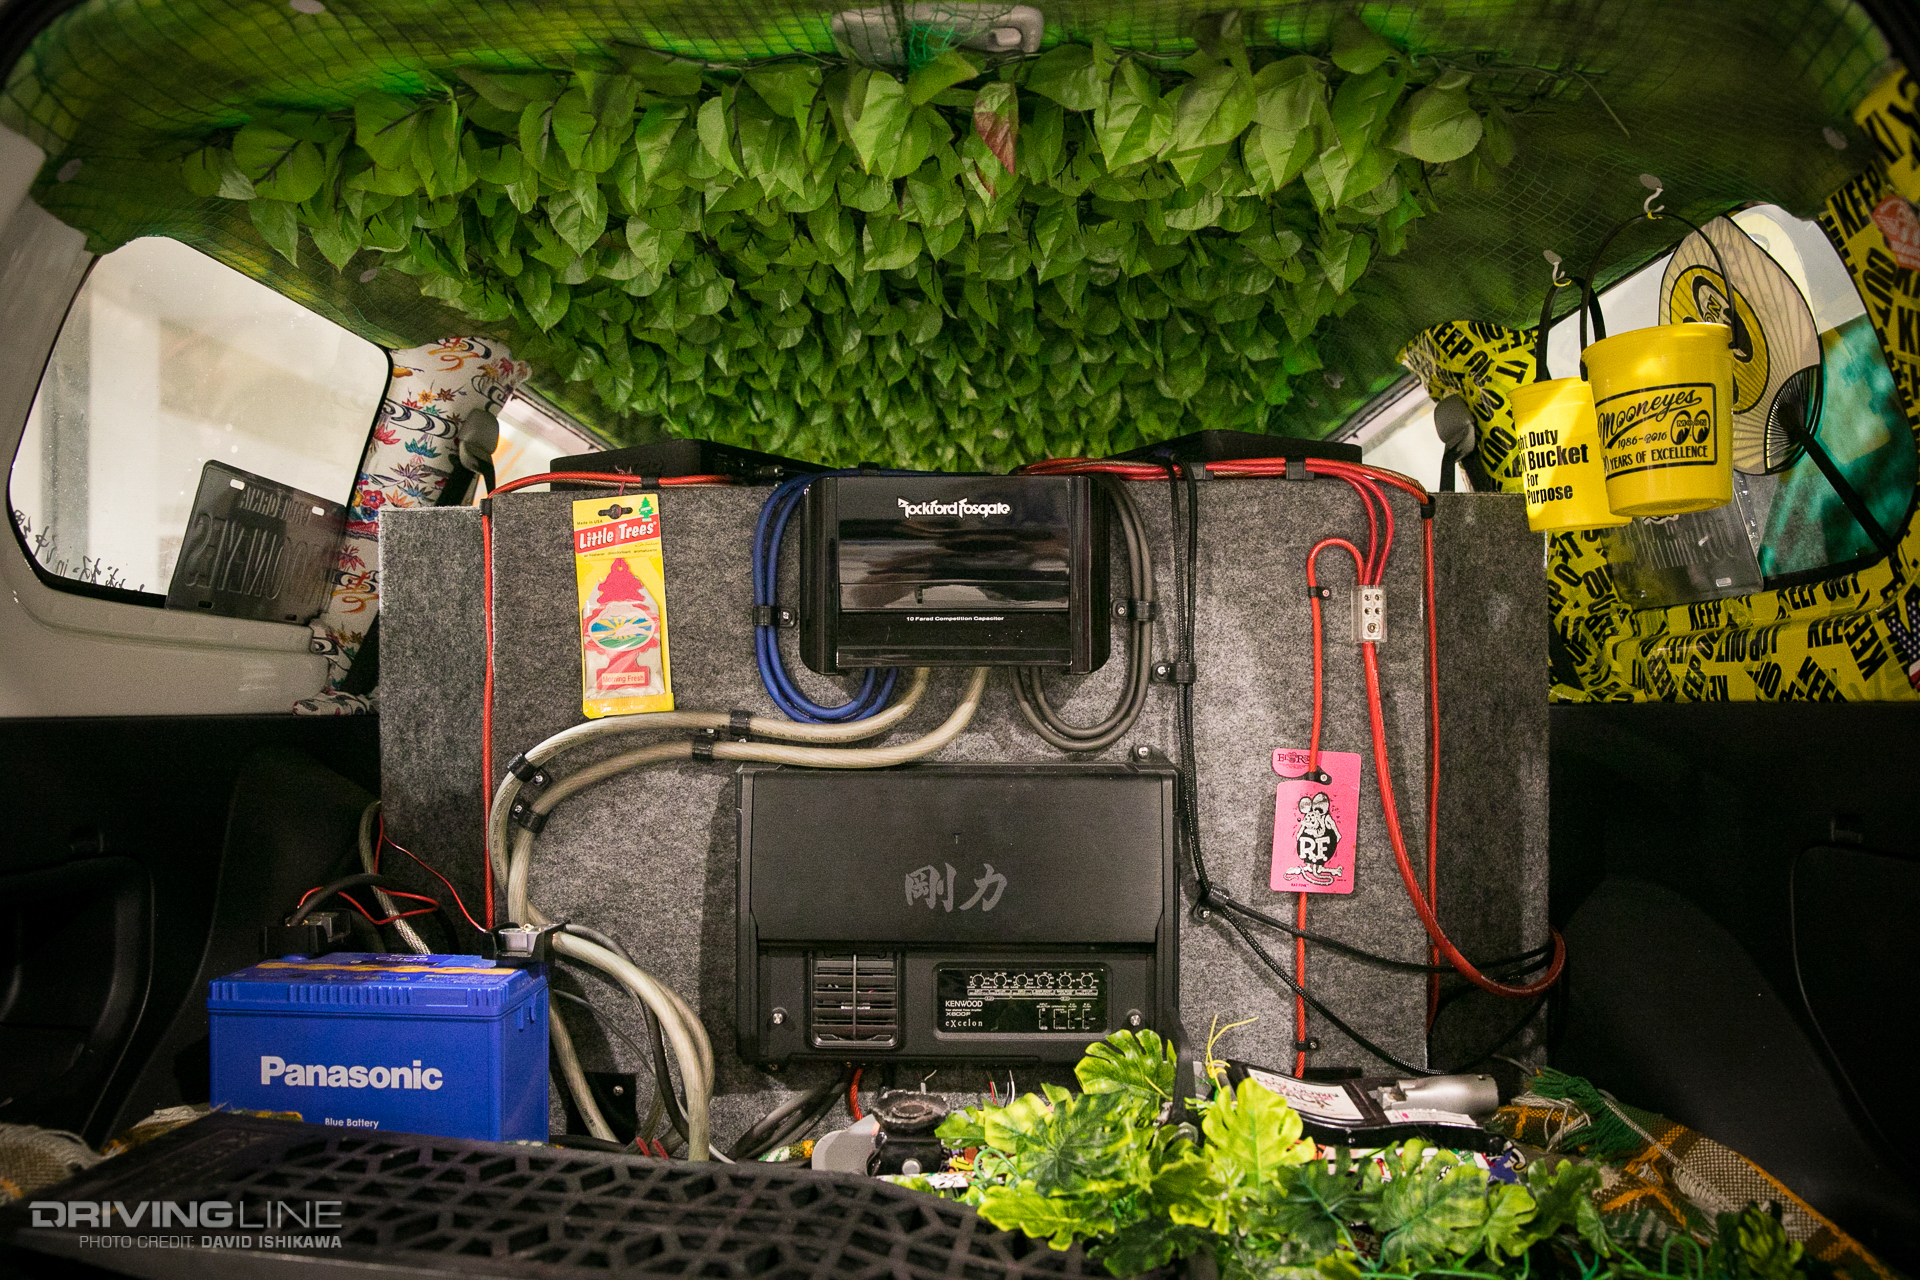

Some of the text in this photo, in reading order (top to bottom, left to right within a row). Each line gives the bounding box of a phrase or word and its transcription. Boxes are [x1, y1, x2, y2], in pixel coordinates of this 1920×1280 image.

[1598, 389, 1702, 447] Mooneyes
[1517, 429, 1559, 451] ght Duty
[1527, 443, 1590, 472] Bucket
[1609, 453, 1634, 471] YEARS
[1635, 450, 1647, 464] OF
[1651, 445, 1709, 462] EXCELLENCE
[1526, 473, 1540, 488] For
[1526, 484, 1574, 507] Purpose
[898, 497, 1012, 519] Rockford Fosgate
[579, 523, 654, 550] Little Trees
[1688, 600, 1722, 632] KEEP
[627, 674, 645, 682] Fresh
[904, 862, 1008, 913] 剛力
[945, 1000, 984, 1008] KENWOOD
[945, 1018, 983, 1028] eXcelon
[260, 1056, 443, 1091] Panasonic
[325, 1116, 380, 1129] Blue Battery
